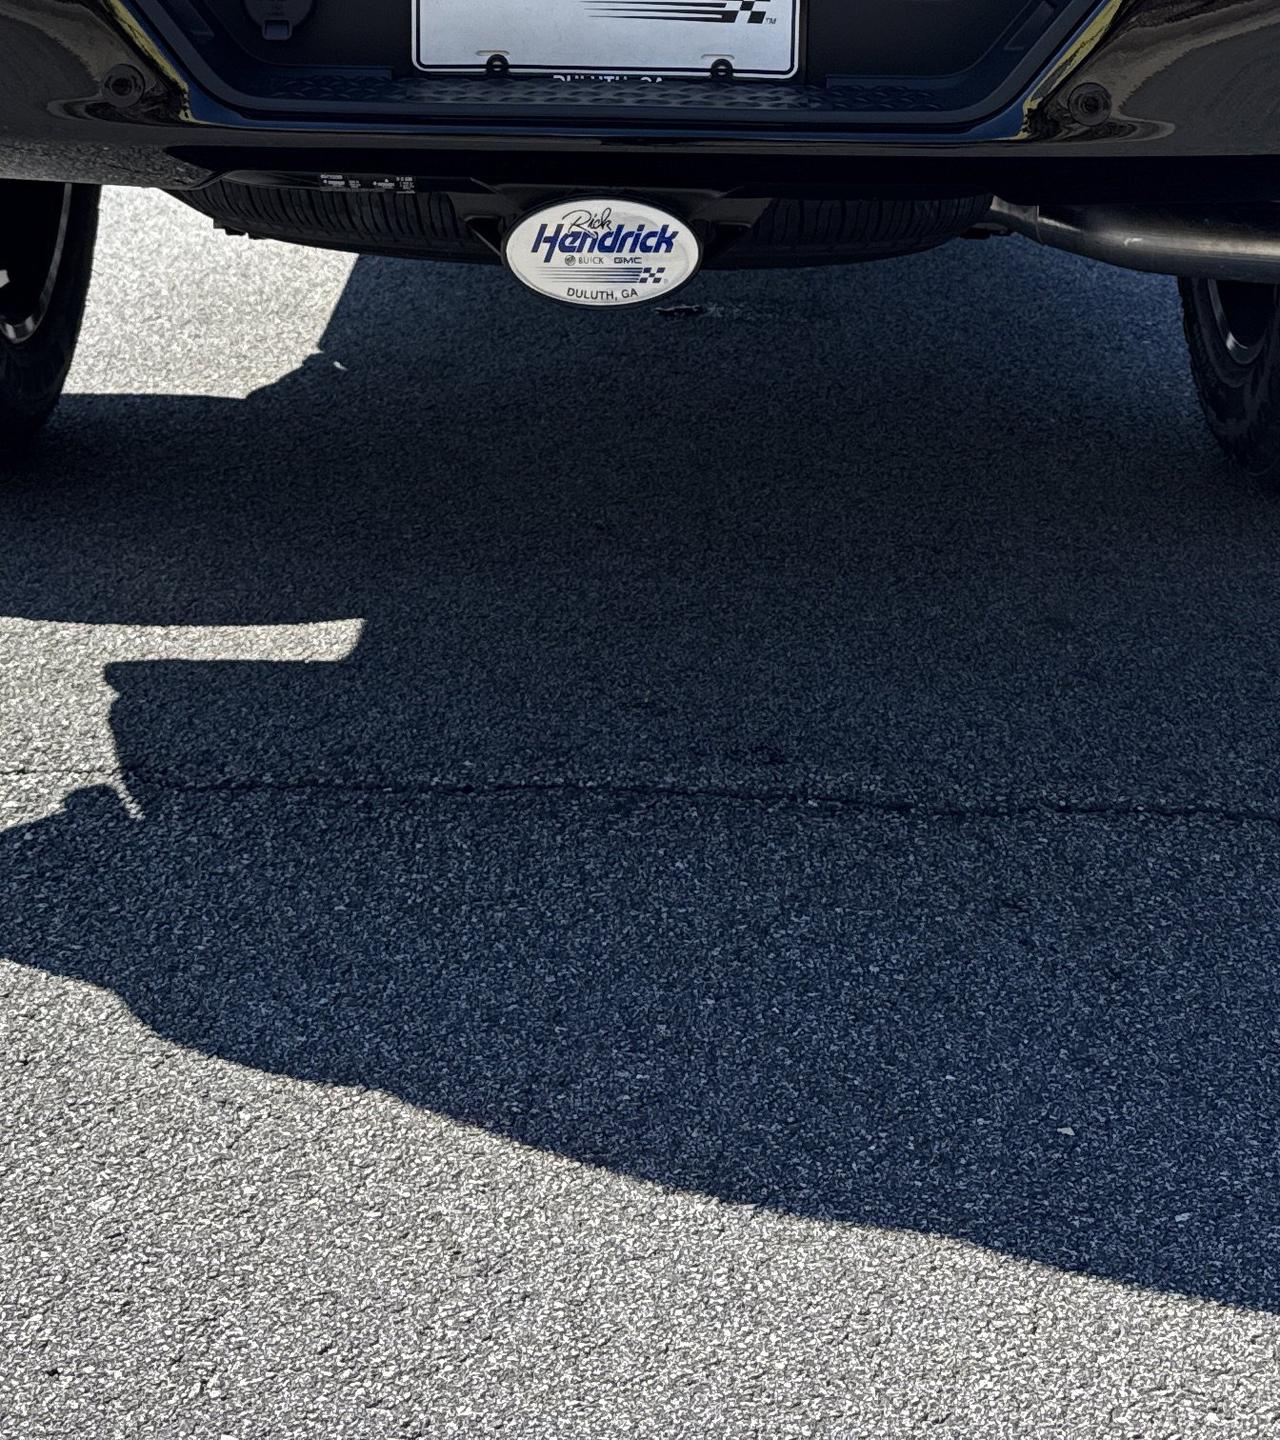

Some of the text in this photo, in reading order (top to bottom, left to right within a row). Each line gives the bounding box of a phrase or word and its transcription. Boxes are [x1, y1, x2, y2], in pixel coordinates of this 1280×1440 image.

[562, 207, 614, 237] Rick
[531, 223, 679, 263] Hendrick
[578, 255, 604, 265] BUICK
[566, 287, 639, 301] DULUTH, GA
